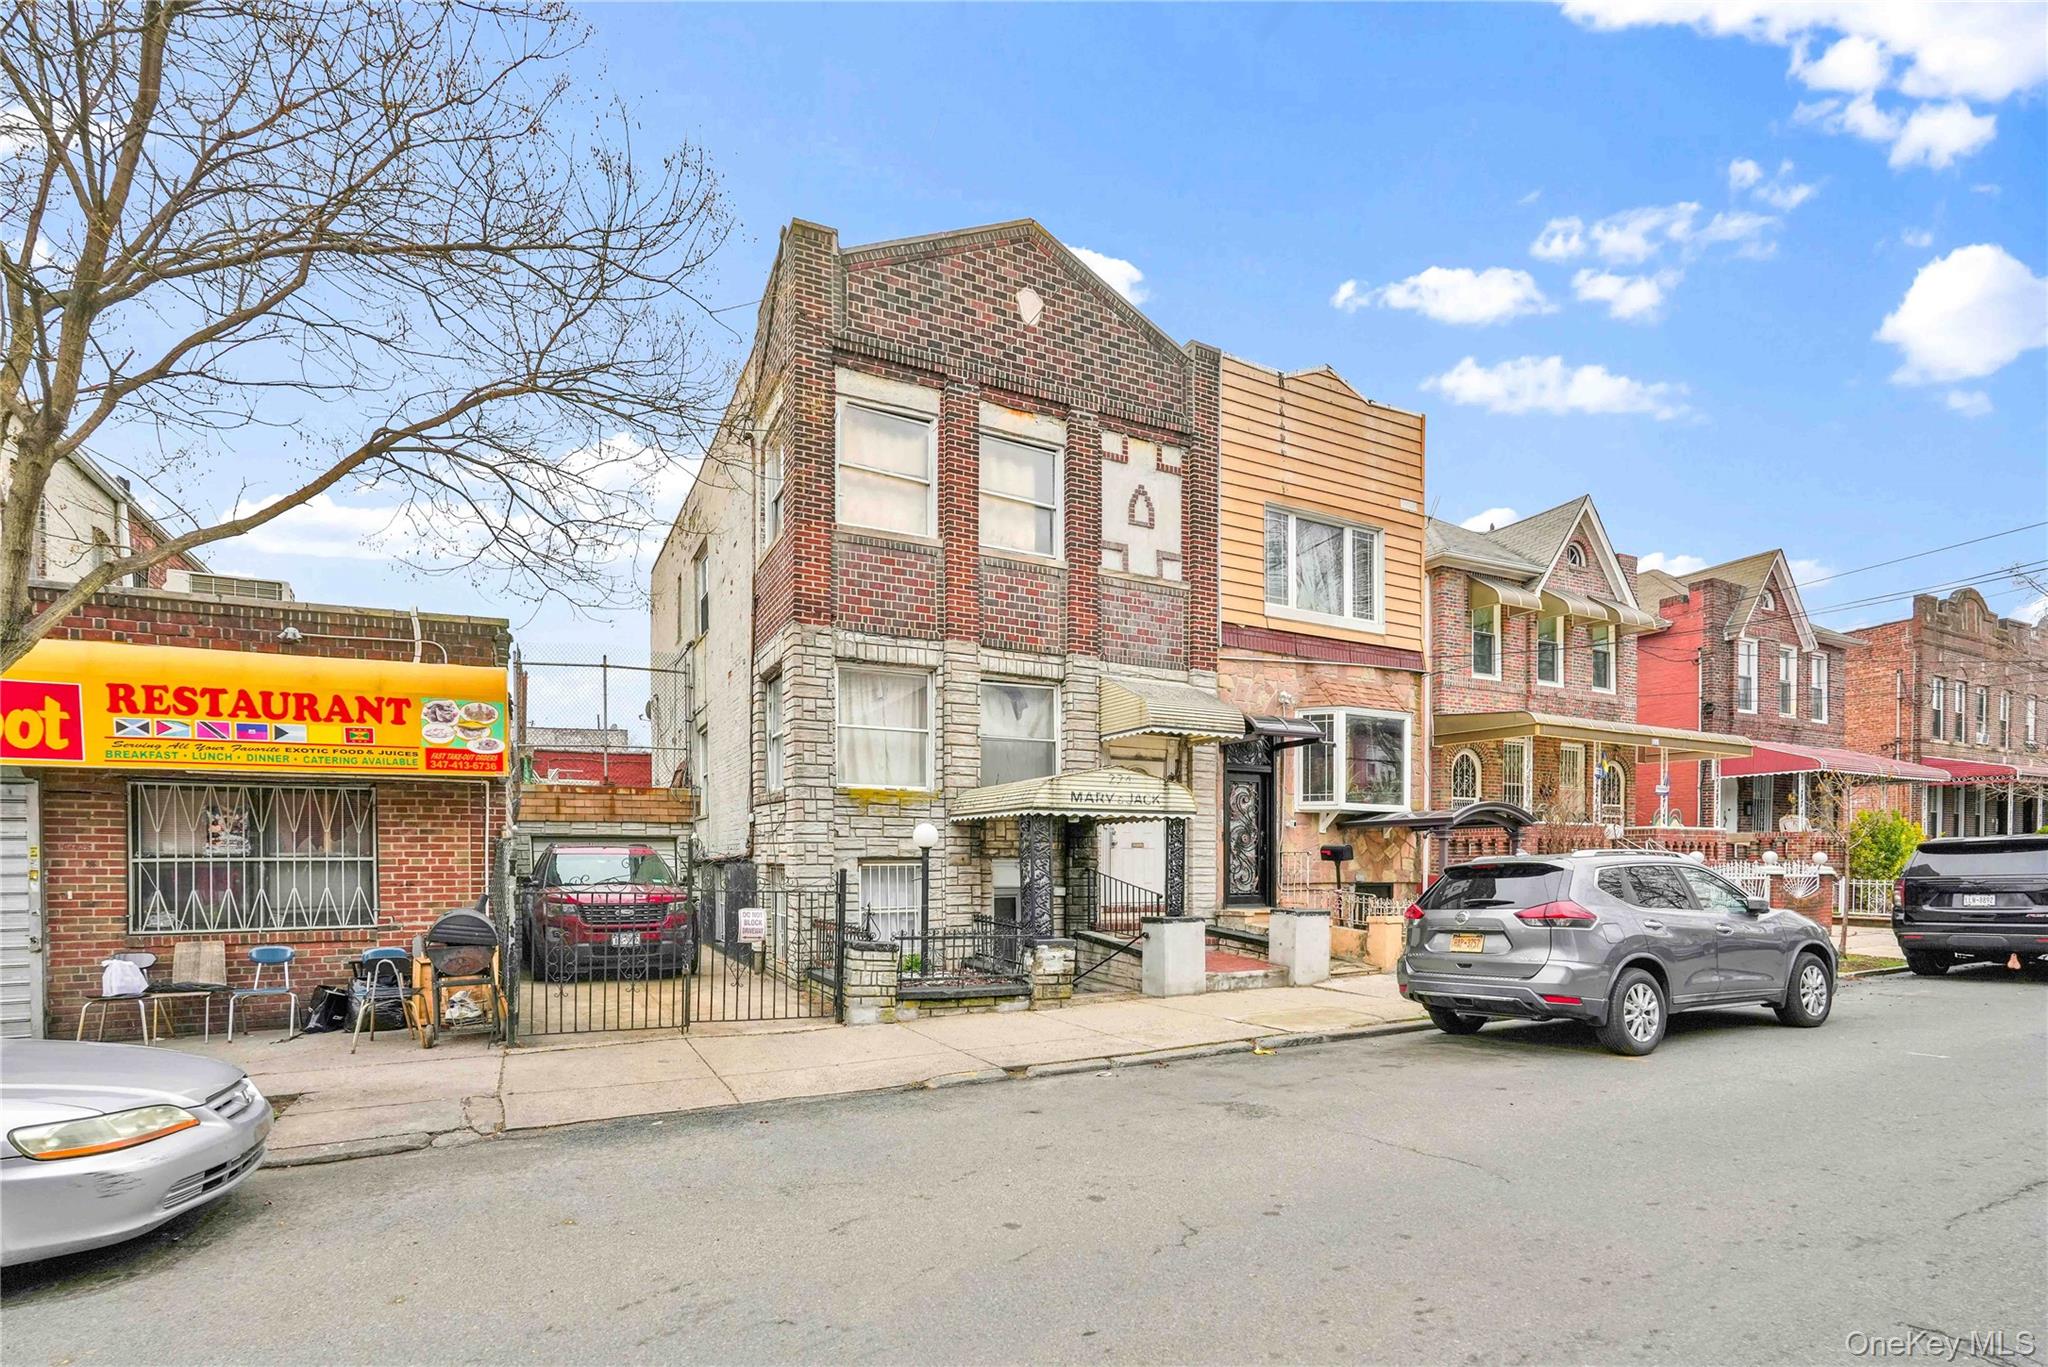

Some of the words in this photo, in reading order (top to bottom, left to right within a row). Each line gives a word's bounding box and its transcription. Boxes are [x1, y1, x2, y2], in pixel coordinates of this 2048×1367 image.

[105, 682, 411, 725] RESTAURANT
[0, 695, 71, 750] ot
[111, 740, 162, 750] Serving
[166, 742, 189, 750] All
[195, 743, 225, 752] Your
[231, 744, 280, 753] Favorite
[105, 750, 178, 760] BREAKFAST
[192, 752, 233, 761] LUNCH
[247, 753, 290, 763] DINNER
[303, 755, 358, 765] CATERING
[362, 757, 419, 766] AVAILABLE
[1128, 794, 1160, 806] JACK
